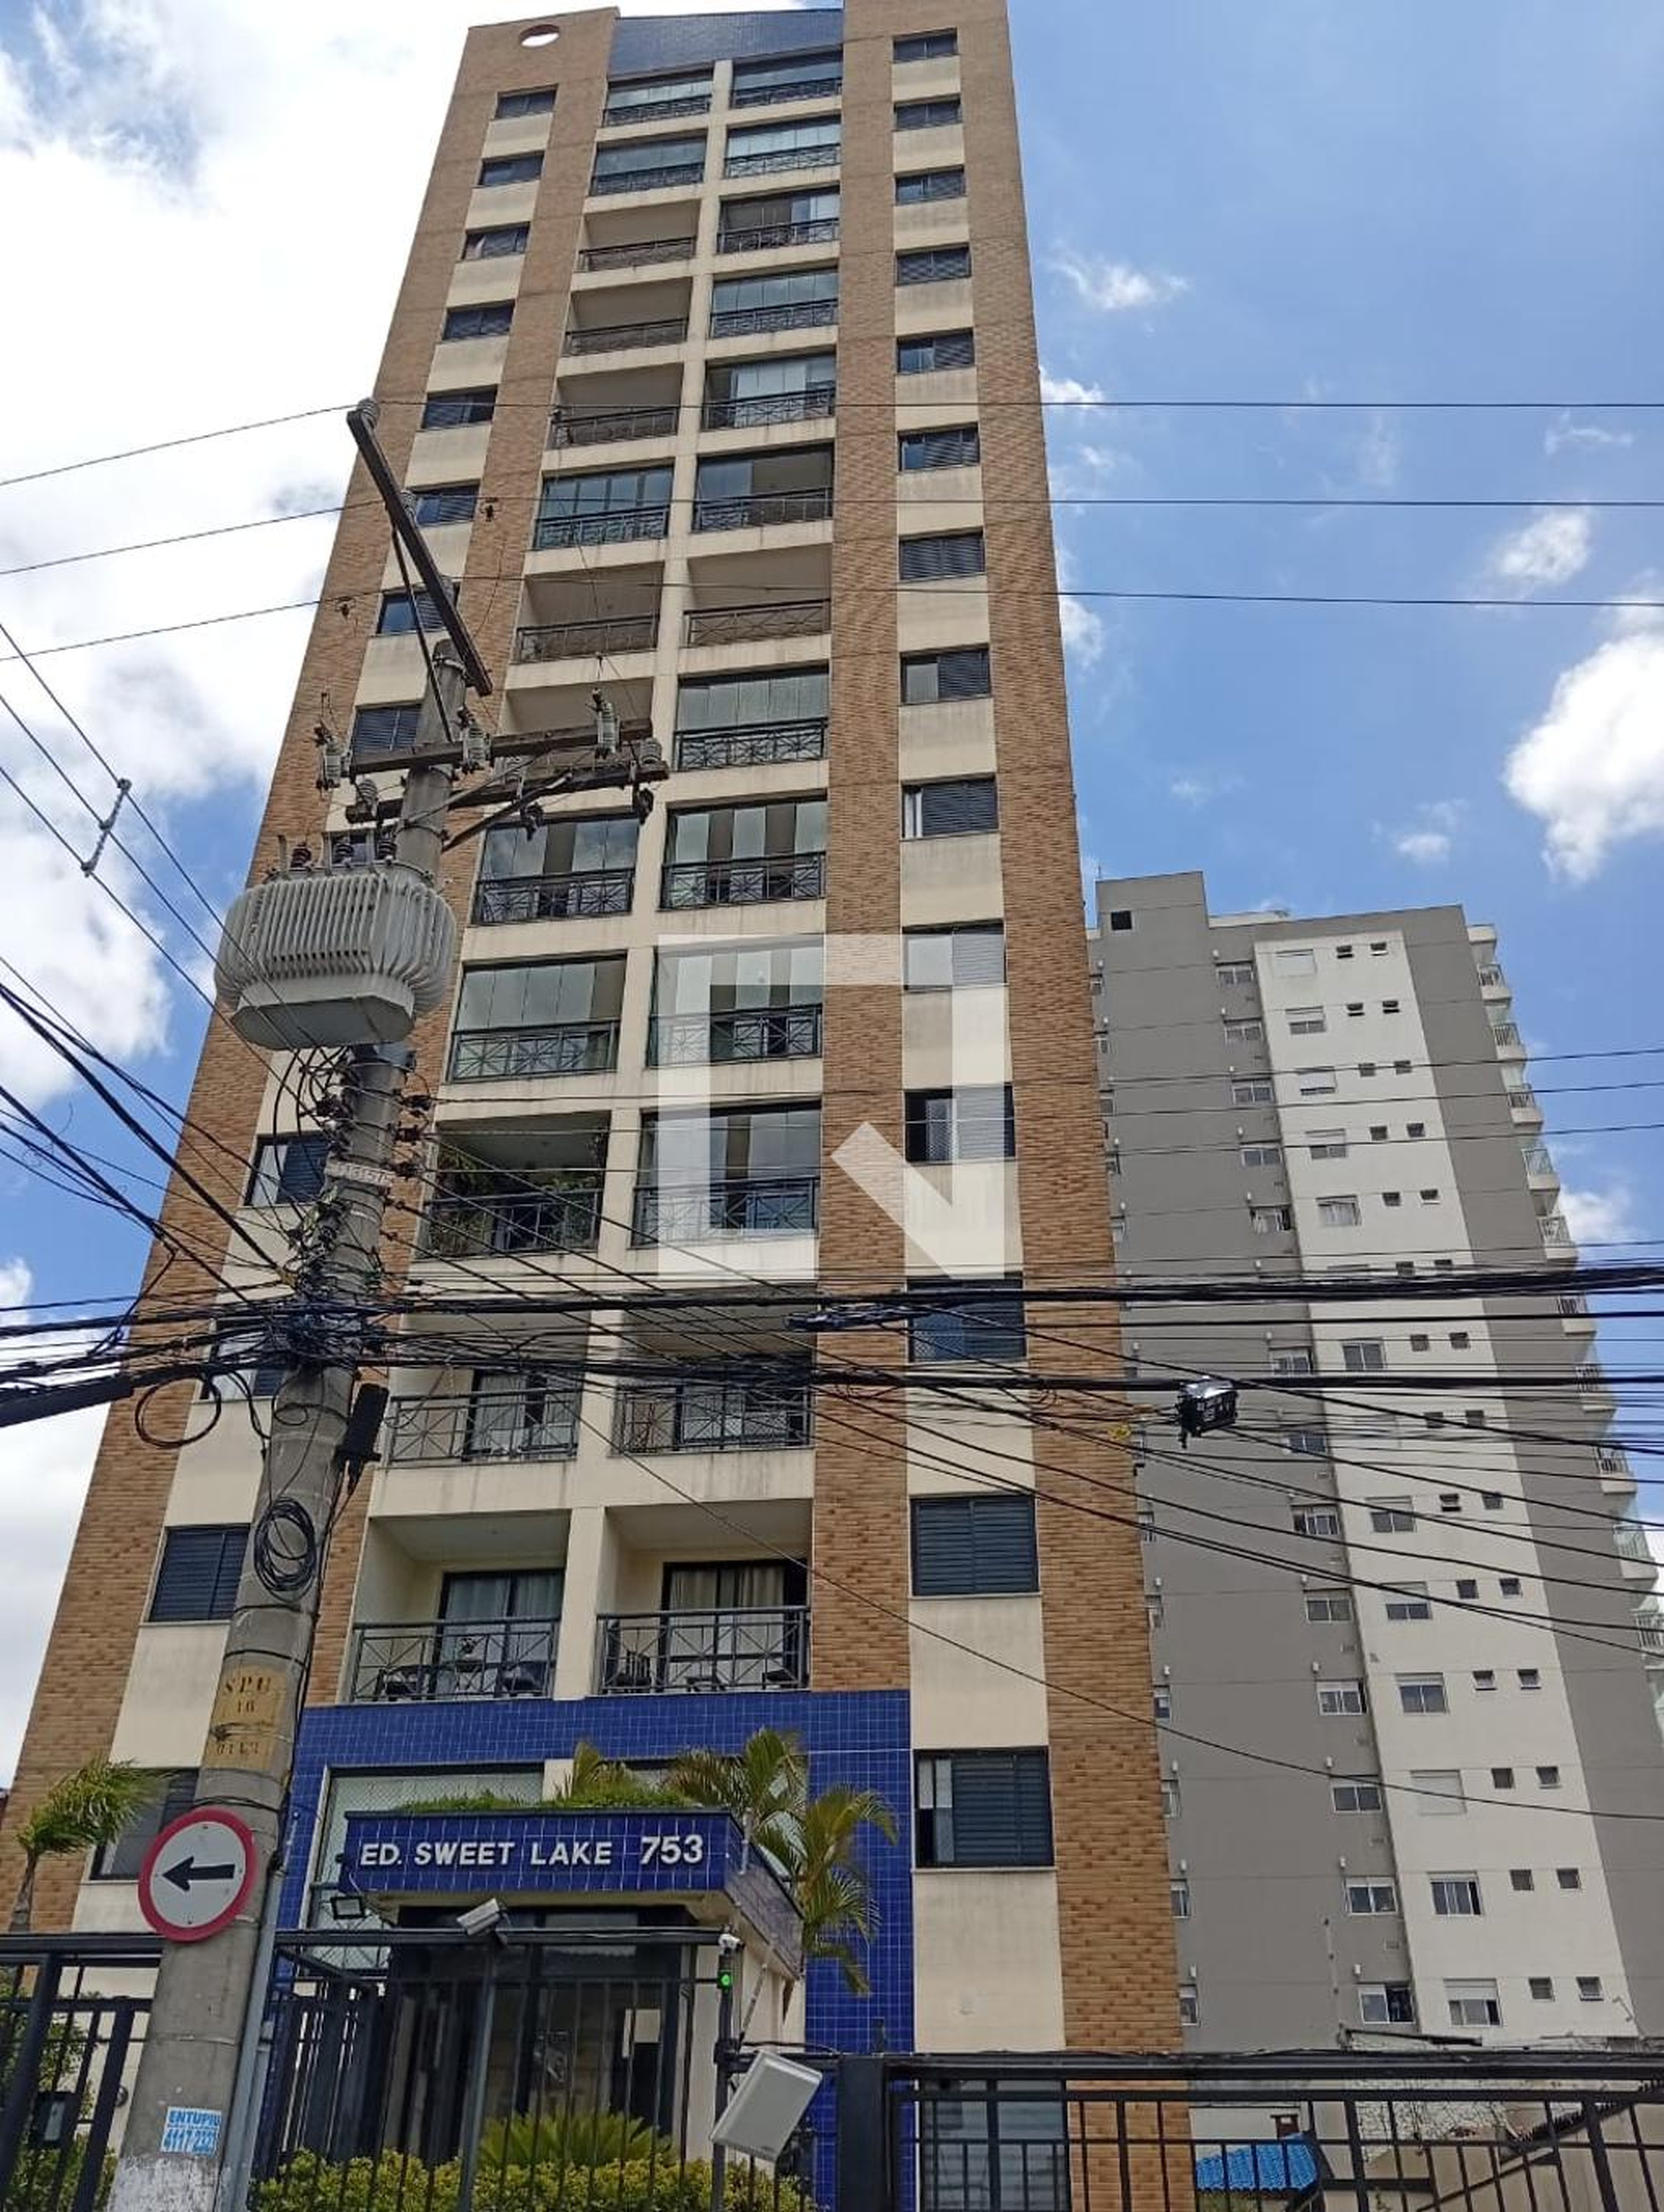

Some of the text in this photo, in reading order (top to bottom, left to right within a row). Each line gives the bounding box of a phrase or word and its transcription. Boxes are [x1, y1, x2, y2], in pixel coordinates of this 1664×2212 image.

[360, 1835, 703, 1865] ED. SWEET LAKE 753
